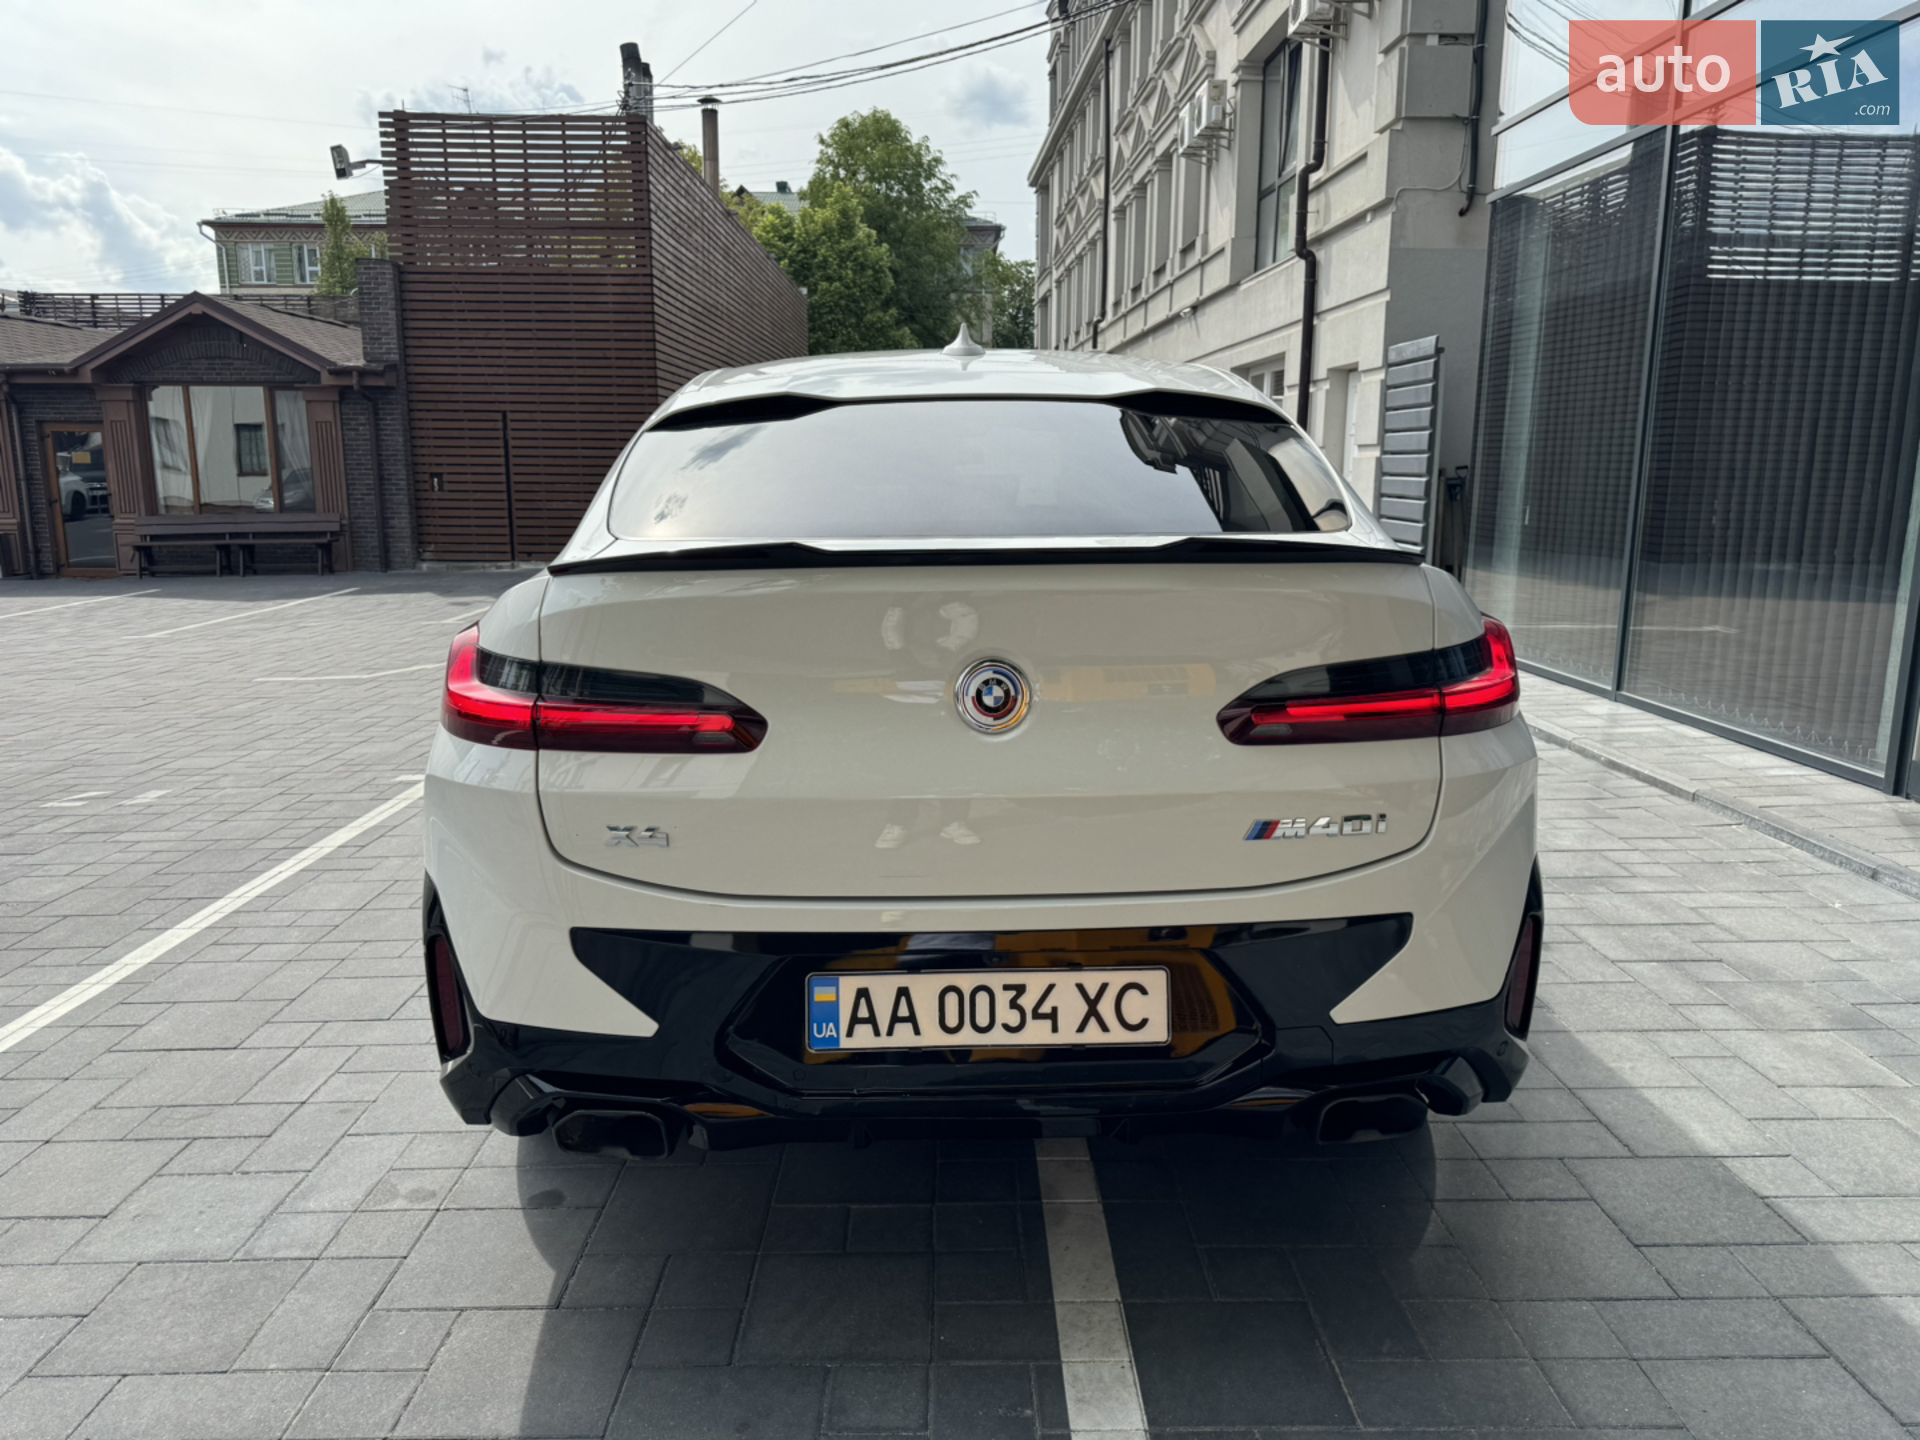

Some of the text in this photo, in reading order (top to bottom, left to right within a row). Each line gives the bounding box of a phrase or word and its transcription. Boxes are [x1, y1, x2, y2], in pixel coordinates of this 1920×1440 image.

[604, 825, 669, 848] X4
[845, 982, 1149, 1038] AA 0034 XC
[813, 1022, 838, 1038] UA
